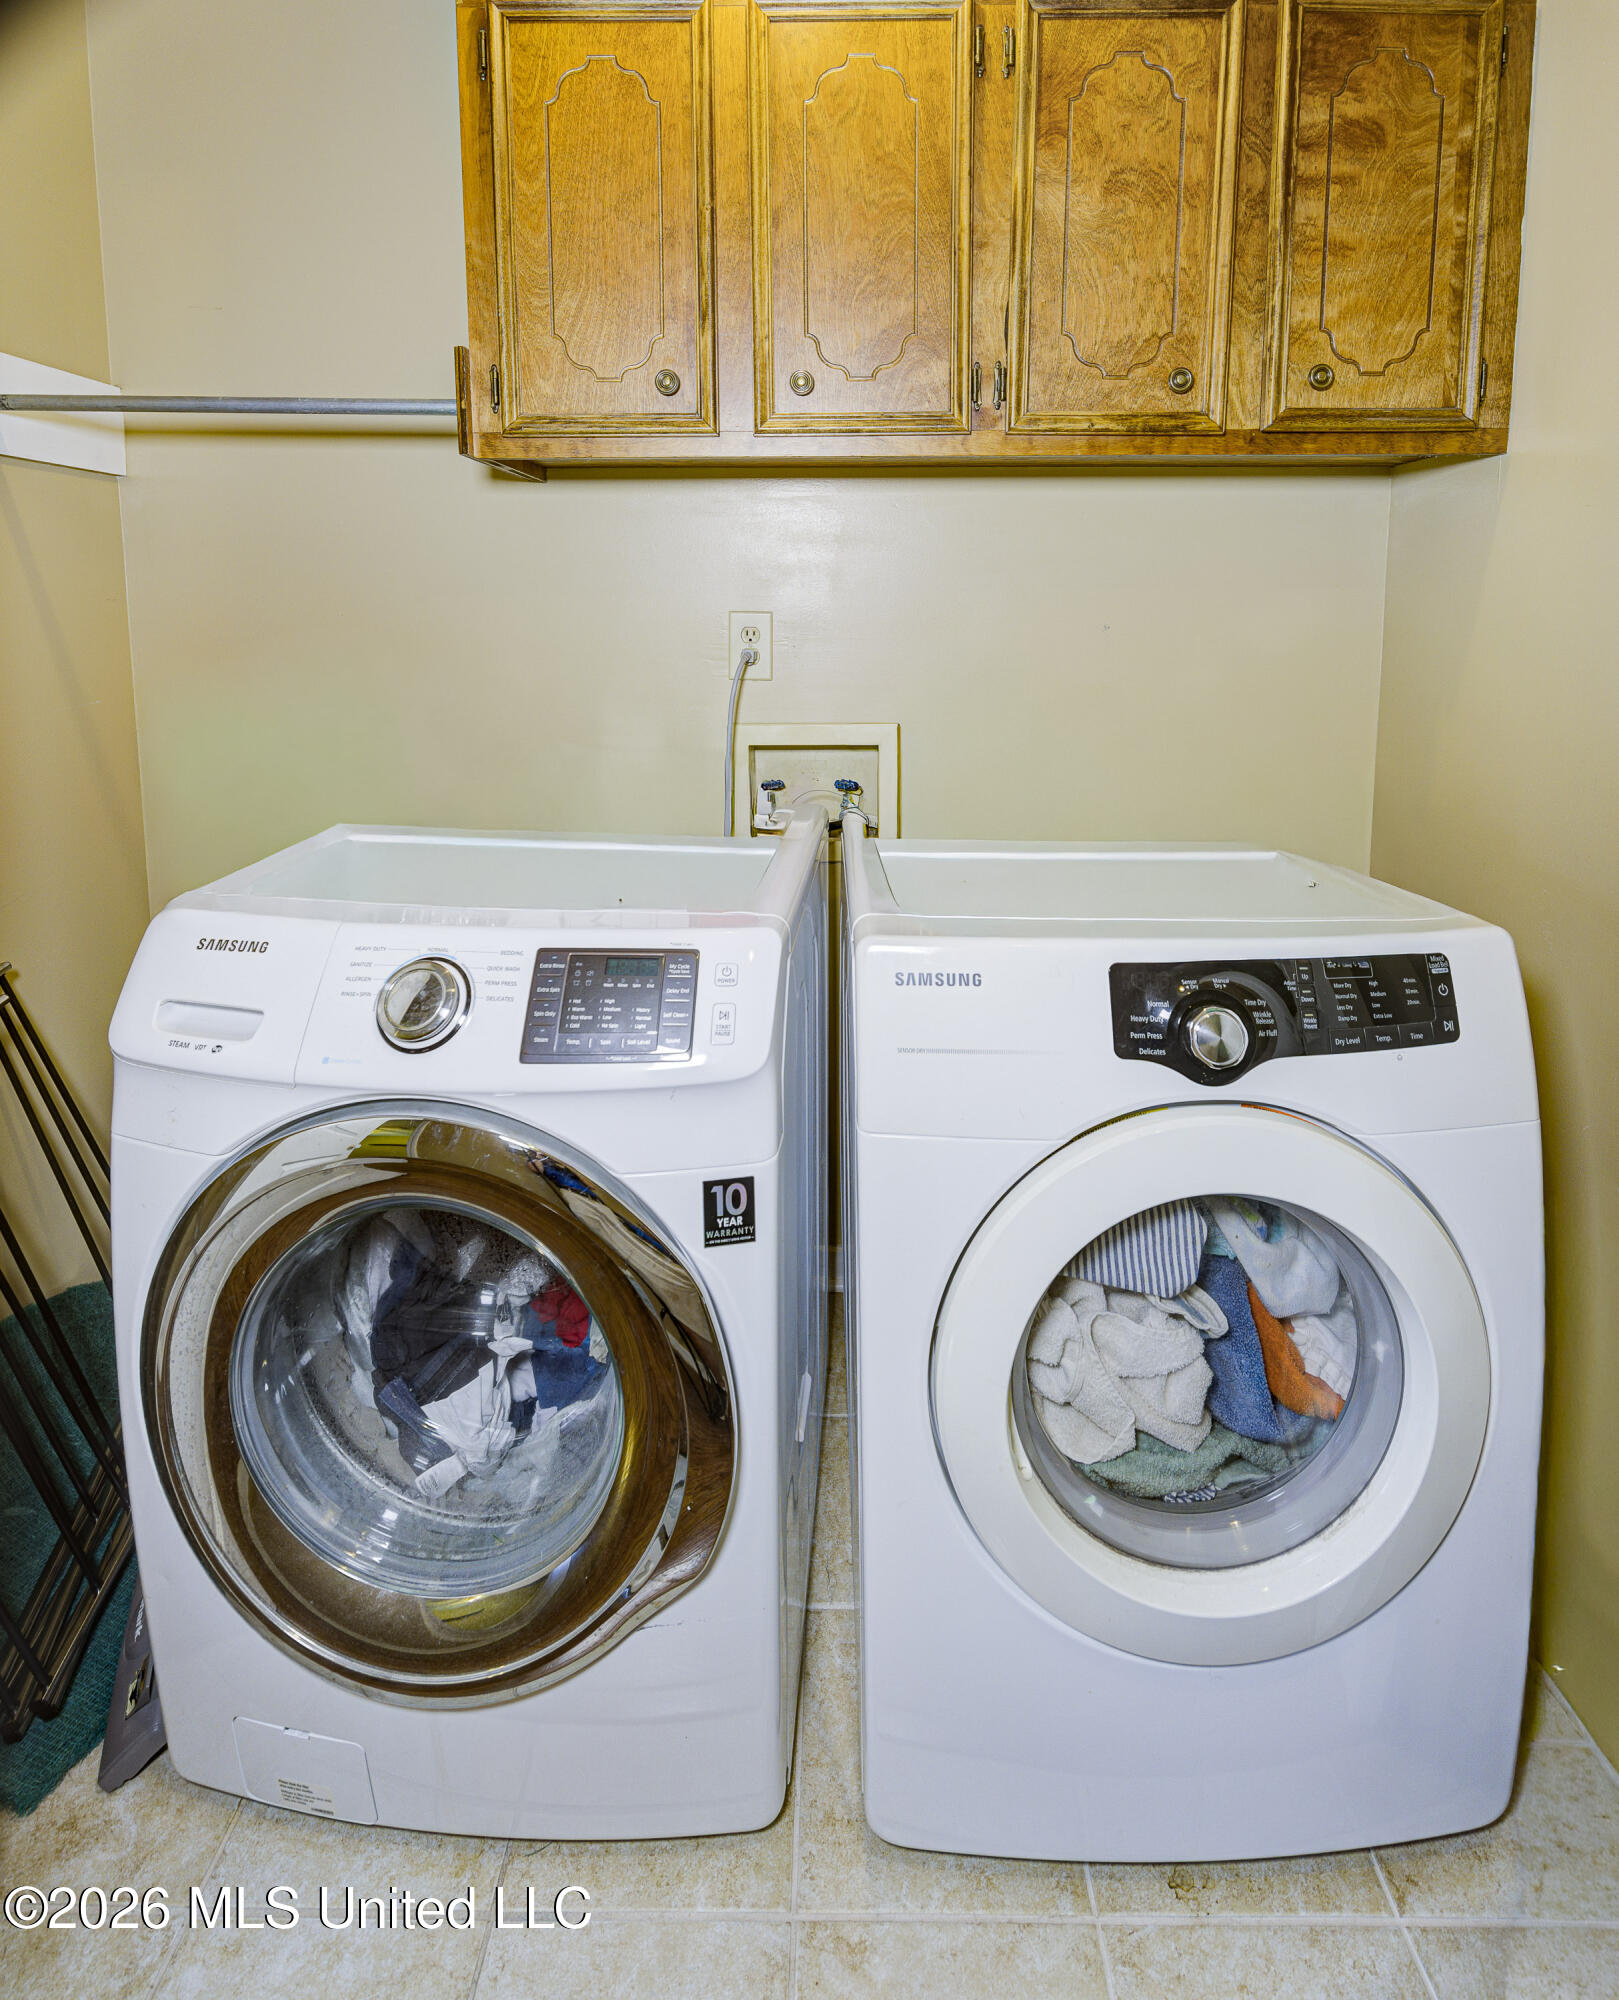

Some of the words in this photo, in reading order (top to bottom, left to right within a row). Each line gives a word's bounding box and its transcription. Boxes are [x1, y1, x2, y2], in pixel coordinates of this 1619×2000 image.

[196, 938, 270, 954] SAMSUNG
[894, 972, 983, 987] SAMSUNG
[1301, 973, 1309, 981] Up
[1146, 1000, 1170, 1008] Normal
[1257, 999, 1267, 1008] Dry
[1130, 1014, 1149, 1024] Heavy
[1149, 1015, 1165, 1024] Duty
[1130, 1031, 1146, 1039] Perm
[1146, 1031, 1163, 1040] Press
[1375, 1034, 1393, 1043] Temp.
[1410, 1032, 1424, 1040] Time
[168, 1039, 191, 1049] STEAM
[1335, 1037, 1346, 1047] Dry
[1346, 1036, 1361, 1045] Level
[1138, 1047, 1167, 1056] Delicates
[710, 1182, 748, 1217] 10
[716, 1215, 744, 1228] YEAR
[705, 1225, 754, 1239] WARRANTY
